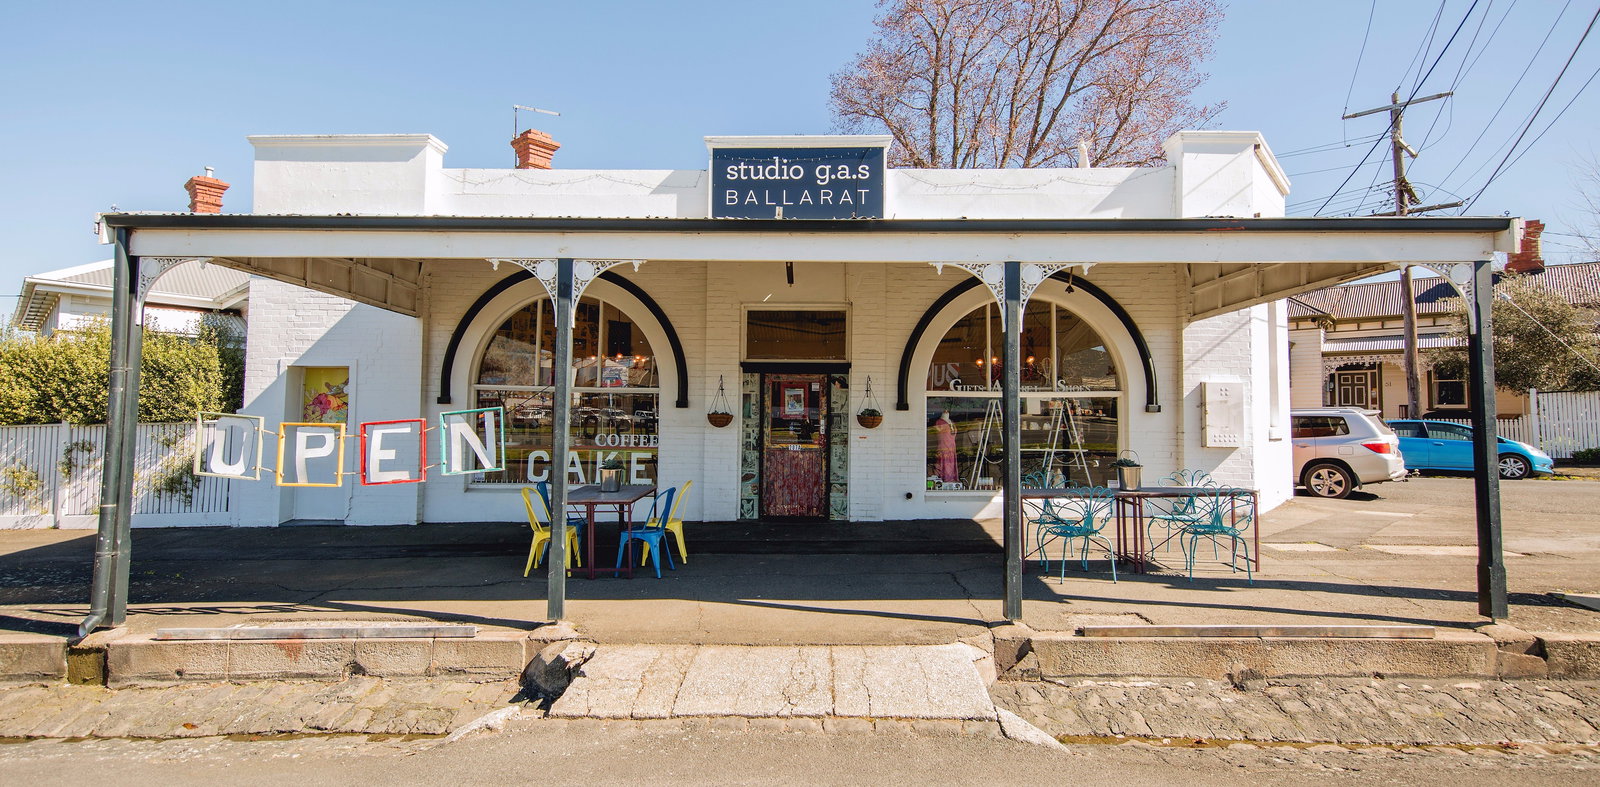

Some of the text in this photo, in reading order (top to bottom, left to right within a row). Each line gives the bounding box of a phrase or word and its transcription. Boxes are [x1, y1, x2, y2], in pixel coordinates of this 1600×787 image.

[726, 156, 870, 186] studio g.a.s
[725, 189, 870, 205] BALLARAT
[210, 409, 496, 484] OPEN
[594, 432, 659, 447] COFFEE
